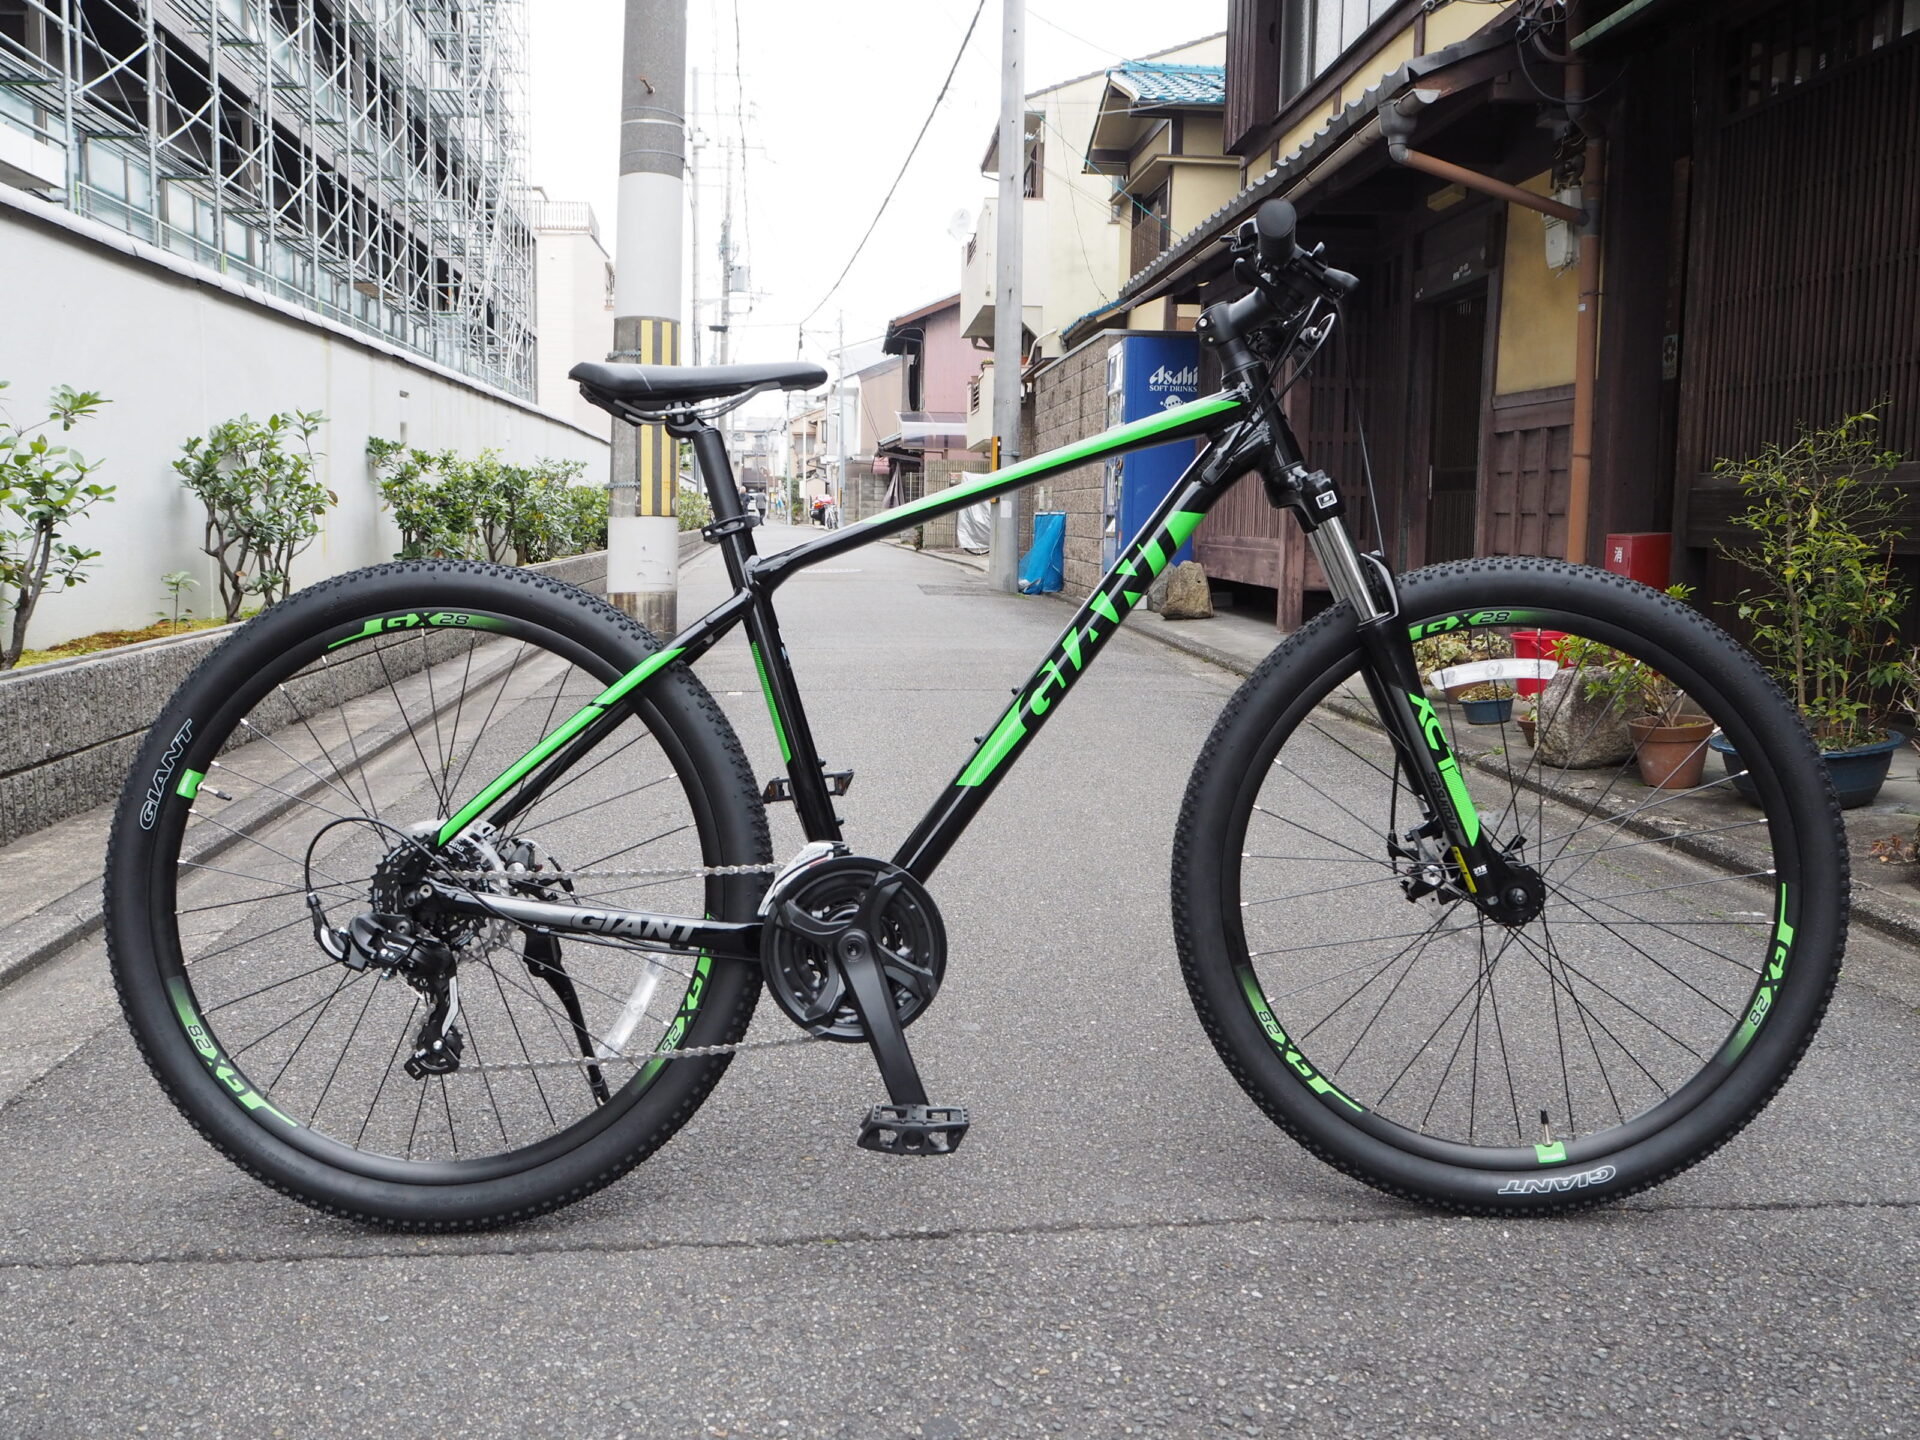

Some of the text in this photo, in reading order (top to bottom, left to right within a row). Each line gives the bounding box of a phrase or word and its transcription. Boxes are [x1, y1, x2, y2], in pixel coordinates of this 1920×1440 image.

[1149, 364, 1199, 385] Asahi
[439, 613, 470, 625] 28
[1018, 520, 1180, 731] GIANT
[1478, 611, 1511, 624] 28
[1408, 693, 1460, 774] XCT
[139, 718, 193, 830] GIANT
[571, 910, 704, 942] GIANT
[1258, 1010, 1281, 1036] 28
[1750, 995, 1769, 1026] 28
[187, 1024, 213, 1050] 28
[1497, 1164, 1617, 1195] GIANT
